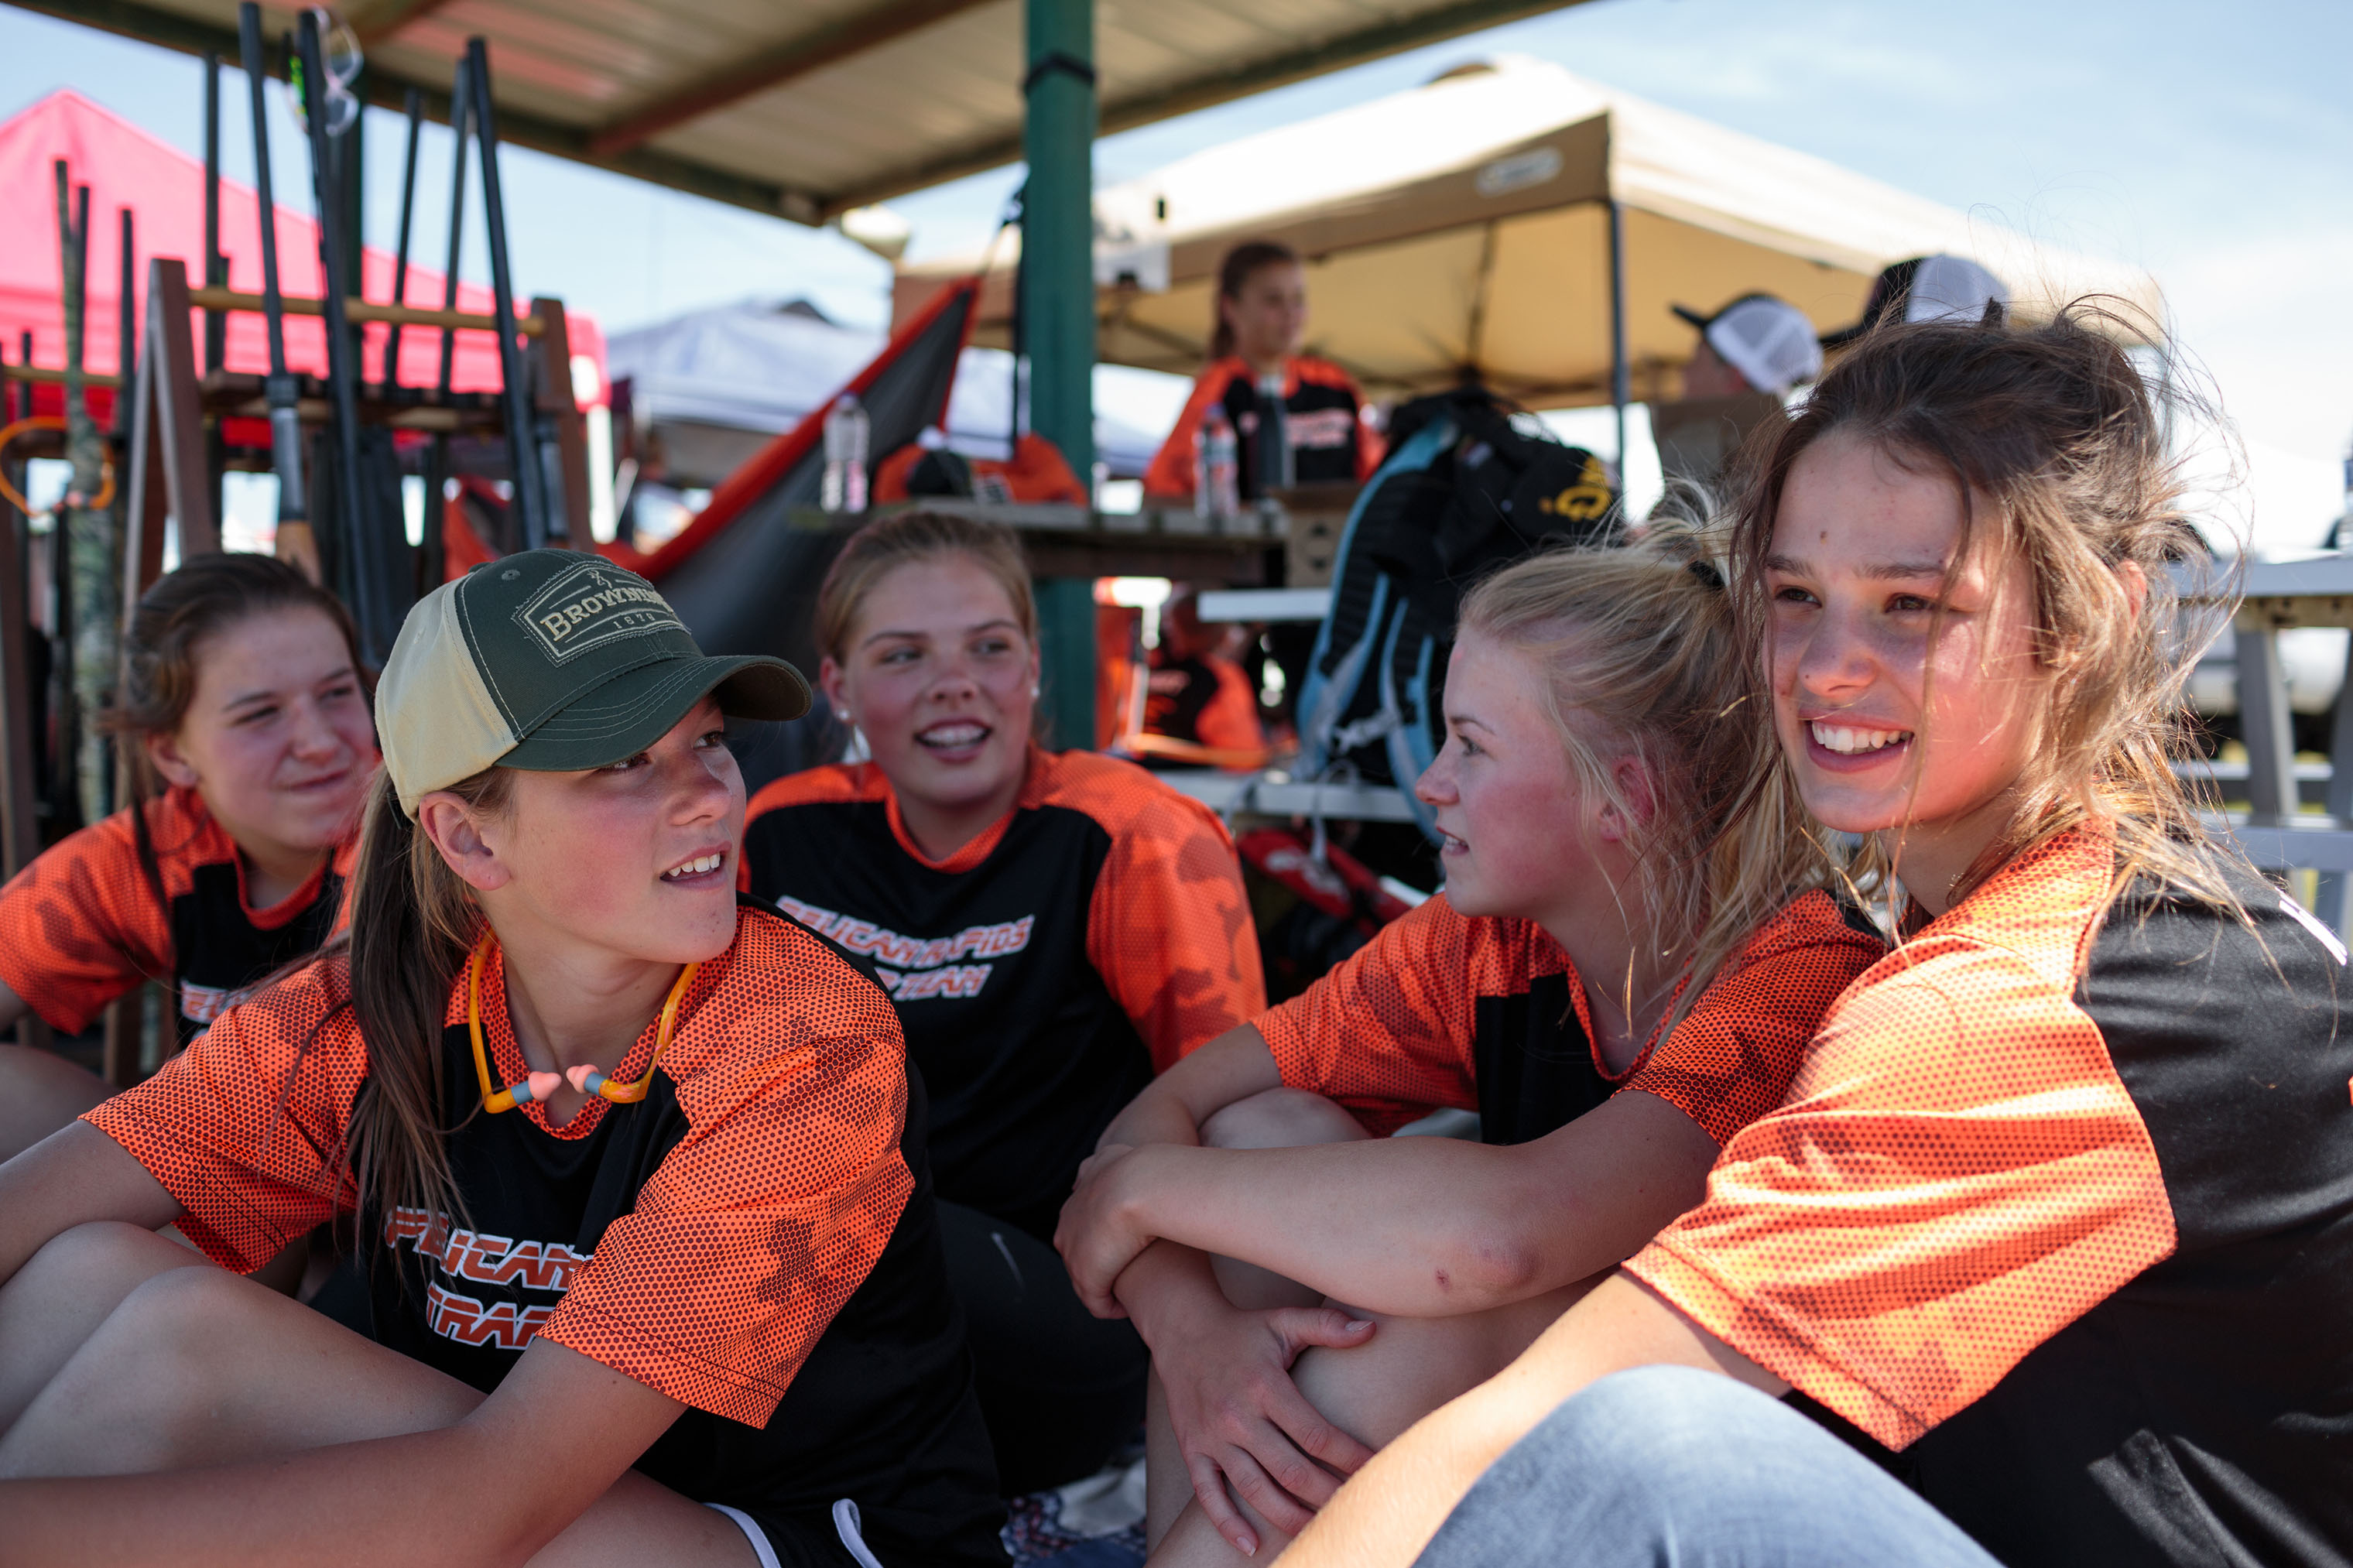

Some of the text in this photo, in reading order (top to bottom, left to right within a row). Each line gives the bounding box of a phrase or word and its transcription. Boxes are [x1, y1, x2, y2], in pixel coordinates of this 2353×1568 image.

[539, 587, 674, 642] BROWNIN
[913, 914, 1036, 969] RAPIDS
[892, 963, 994, 1001] TEAM
